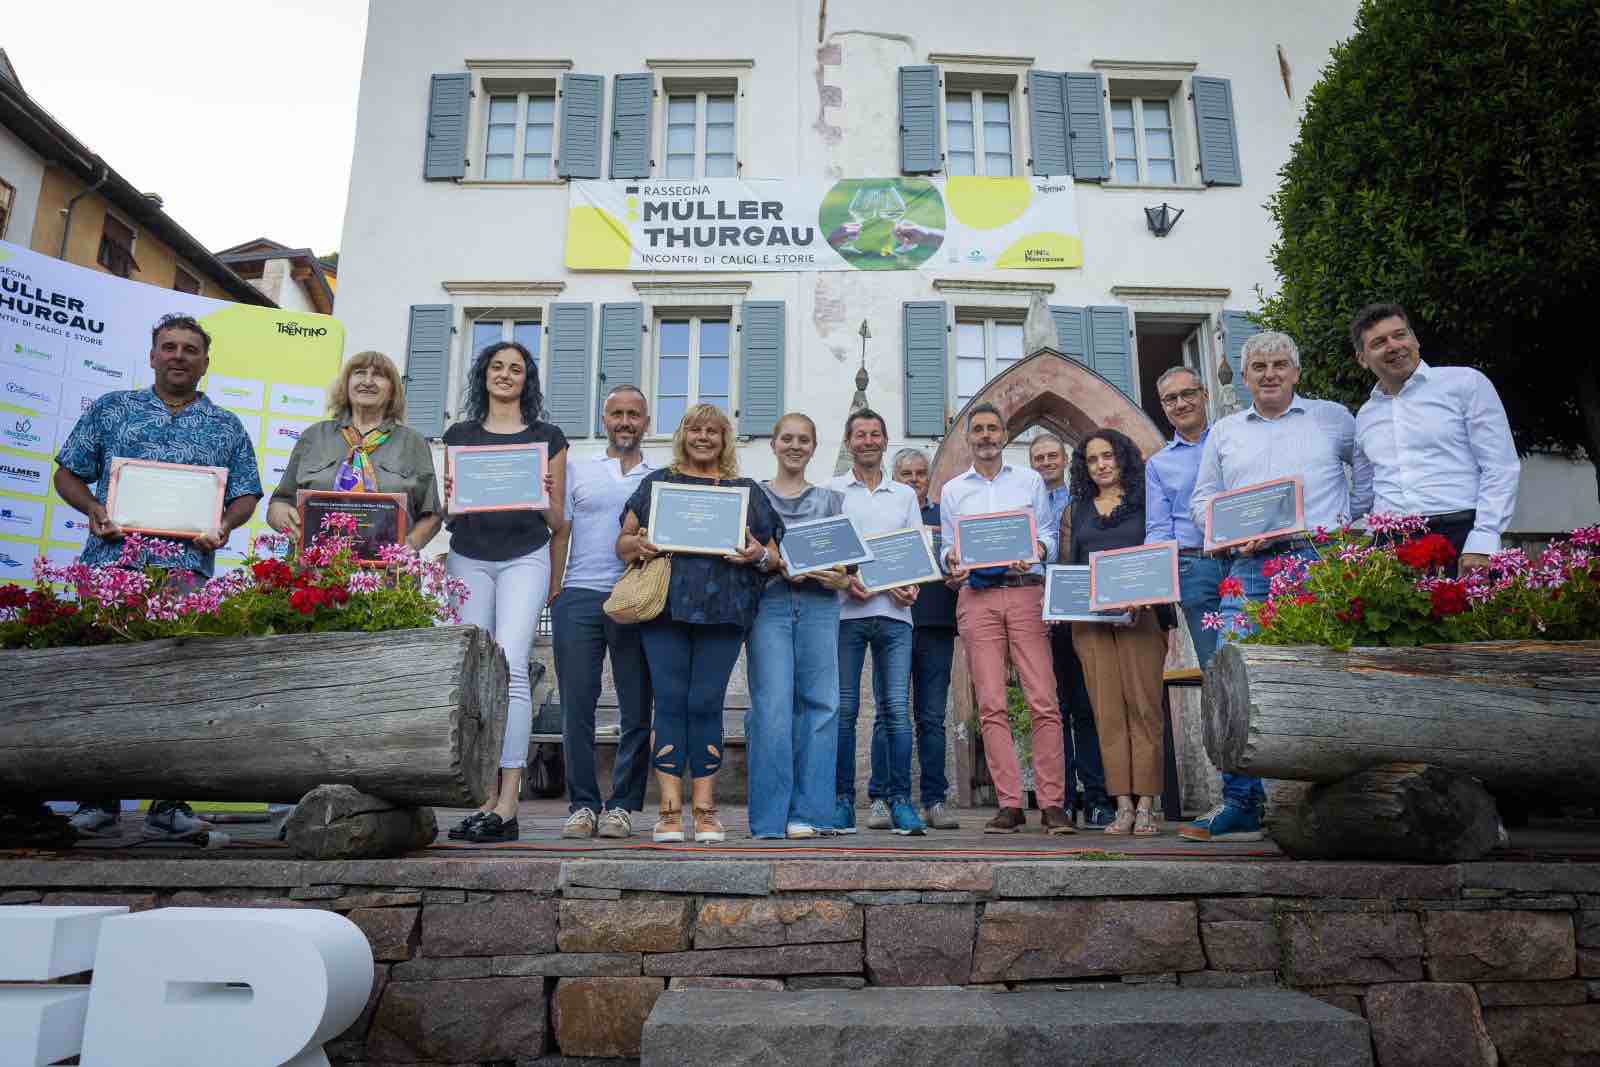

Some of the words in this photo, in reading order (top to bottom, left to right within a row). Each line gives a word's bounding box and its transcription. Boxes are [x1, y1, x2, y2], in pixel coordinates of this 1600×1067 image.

[643, 184, 711, 196] RASSEGNA
[643, 198, 784, 222] MÜLLER
[643, 226, 814, 248] THURGAU
[641, 253, 698, 265] INCONTRI
[703, 255, 715, 265] DI
[720, 254, 757, 265] CALICI
[762, 254, 769, 265] E
[774, 253, 816, 264] STORIE
[275, 321, 328, 338] TRENTINO
